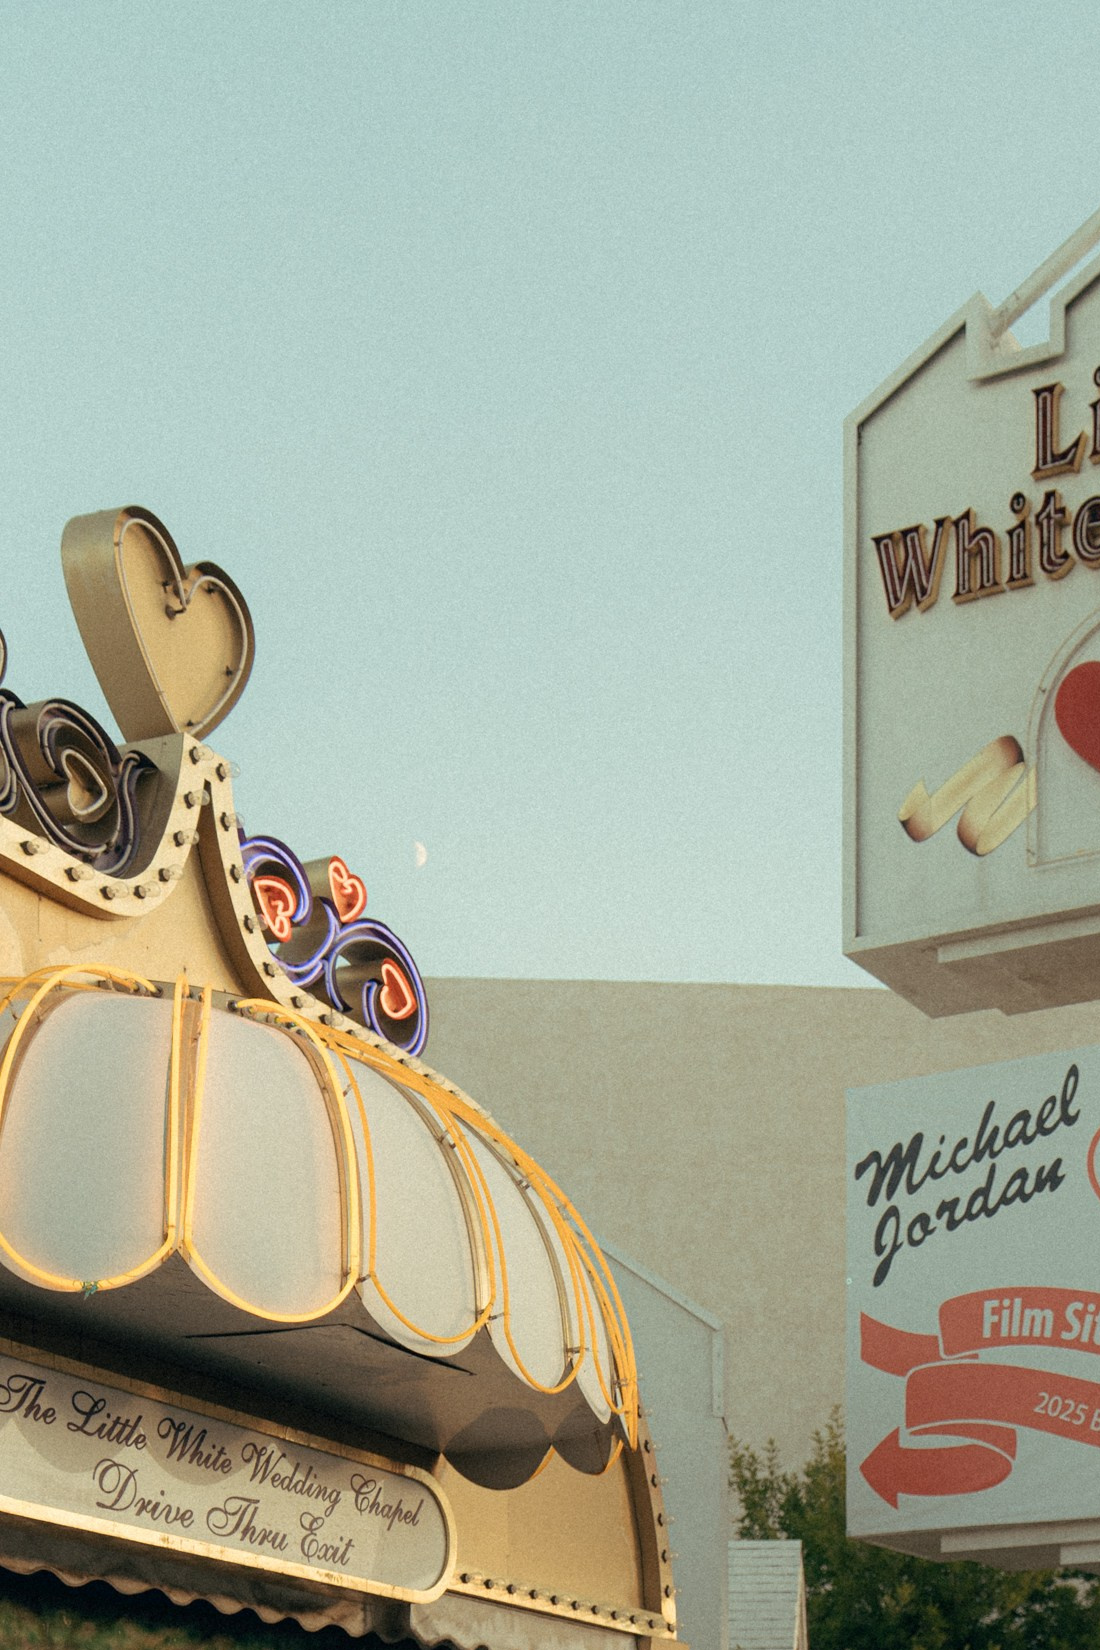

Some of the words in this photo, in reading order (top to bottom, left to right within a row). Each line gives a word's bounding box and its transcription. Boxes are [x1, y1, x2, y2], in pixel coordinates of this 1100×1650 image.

[855, 1063, 1081, 1207] Michael
[872, 1157, 1066, 1288] Jordan
[982, 1297, 1054, 1339] Film
[0, 1374, 57, 1425] The
[66, 1390, 147, 1450] Little
[157, 1417, 233, 1474] White
[241, 1442, 342, 1517] Wedding
[350, 1473, 424, 1531] Chapel
[1032, 1391, 1089, 1425] 2025
[92, 1458, 195, 1528] Drive
[206, 1496, 289, 1550] Thru
[299, 1511, 355, 1566] Exit
